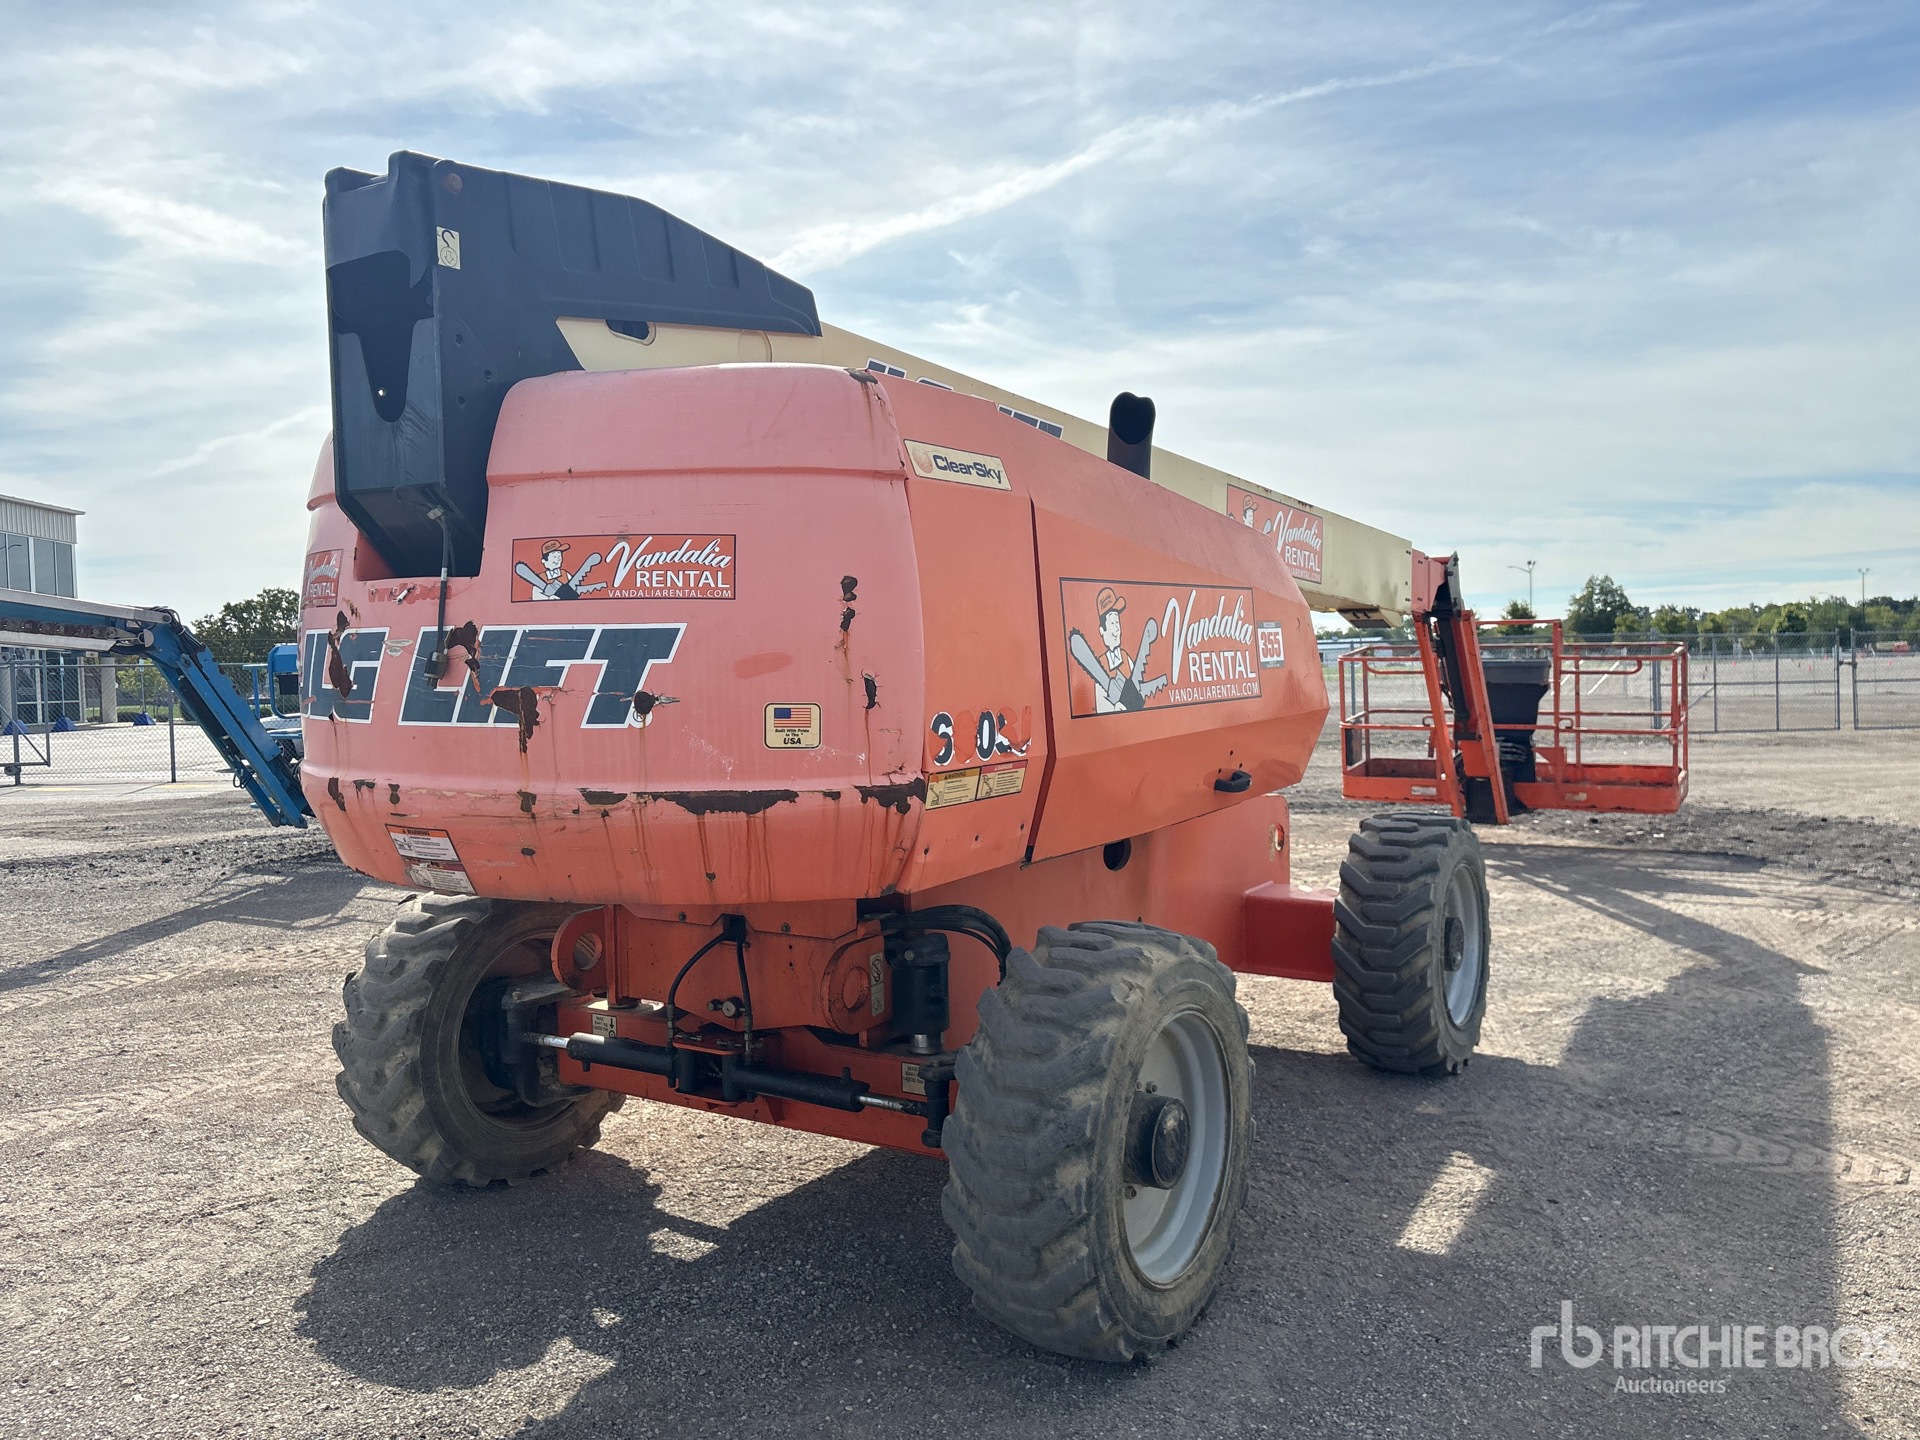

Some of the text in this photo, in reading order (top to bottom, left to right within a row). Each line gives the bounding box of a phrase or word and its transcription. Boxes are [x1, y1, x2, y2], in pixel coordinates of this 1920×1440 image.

[932, 454, 1002, 484] ClearSky
[1273, 509, 1321, 554] Vandalia
[605, 536, 732, 587] Vandalia
[1284, 545, 1320, 572] RENTAL
[635, 570, 730, 588] RENTAL
[607, 589, 732, 598] VANDALIARENTAL.COM
[1161, 589, 1253, 685] Vandalia
[1260, 631, 1281, 658] 355
[398, 623, 687, 728] LIFT
[1188, 650, 1256, 683] RENTAL
[1168, 683, 1259, 703] VANDALIARENTAL.COM
[783, 737, 801, 745] USA
